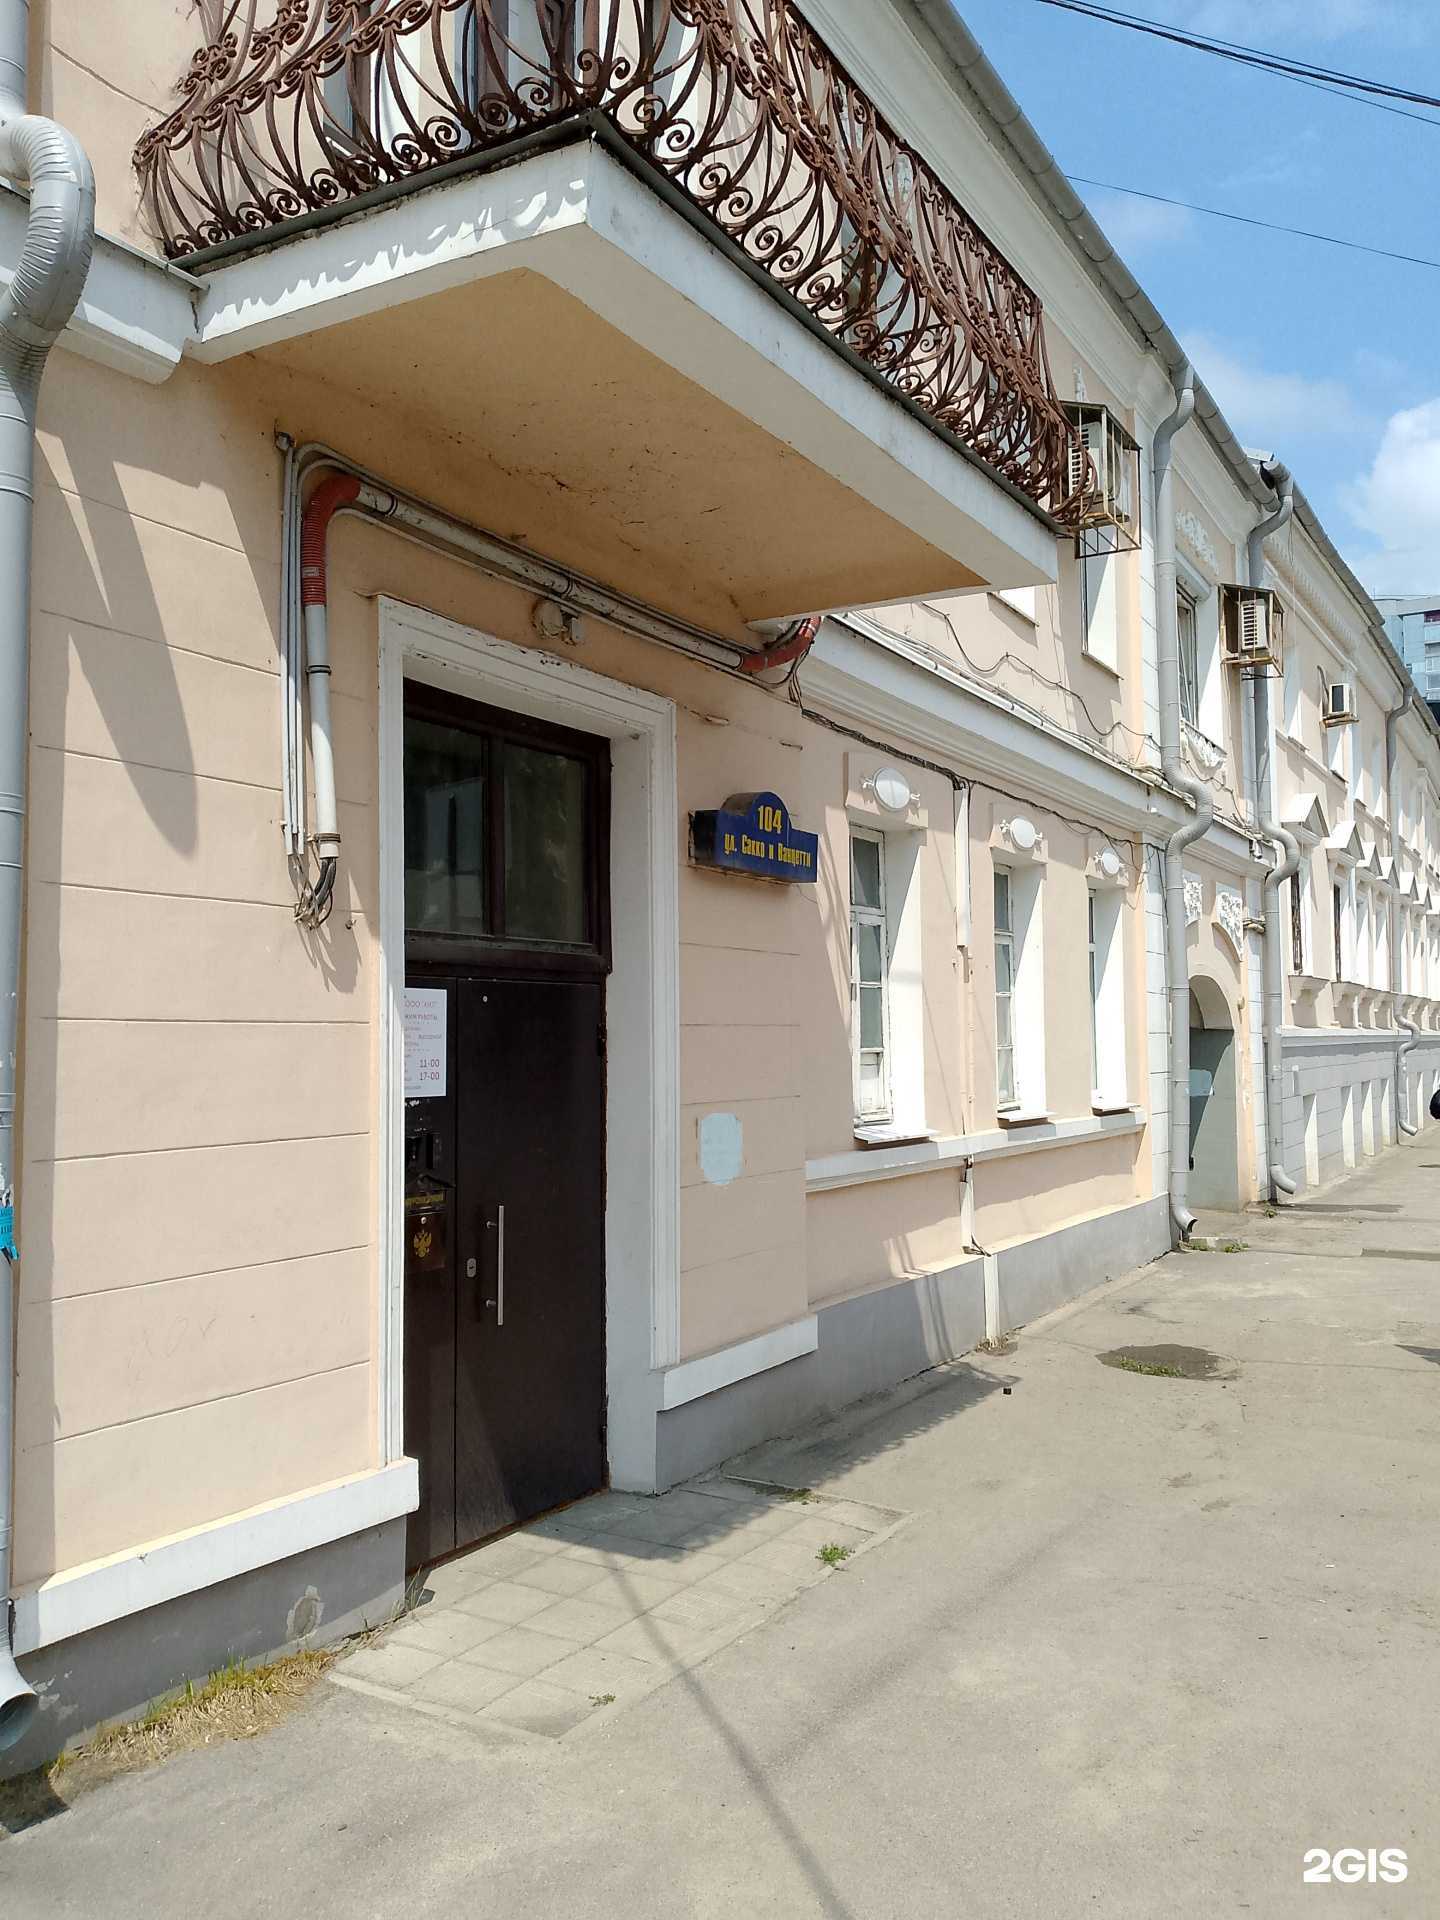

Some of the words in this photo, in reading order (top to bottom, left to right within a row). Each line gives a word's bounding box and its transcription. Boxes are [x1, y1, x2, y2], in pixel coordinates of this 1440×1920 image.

[758, 805, 782, 834] 104
[724, 833, 738, 855] ул.
[742, 834, 765, 858] Сакко
[769, 844, 774, 860] и
[778, 842, 811, 868] Ванцетти
[419, 1059, 440, 1068] 11-00
